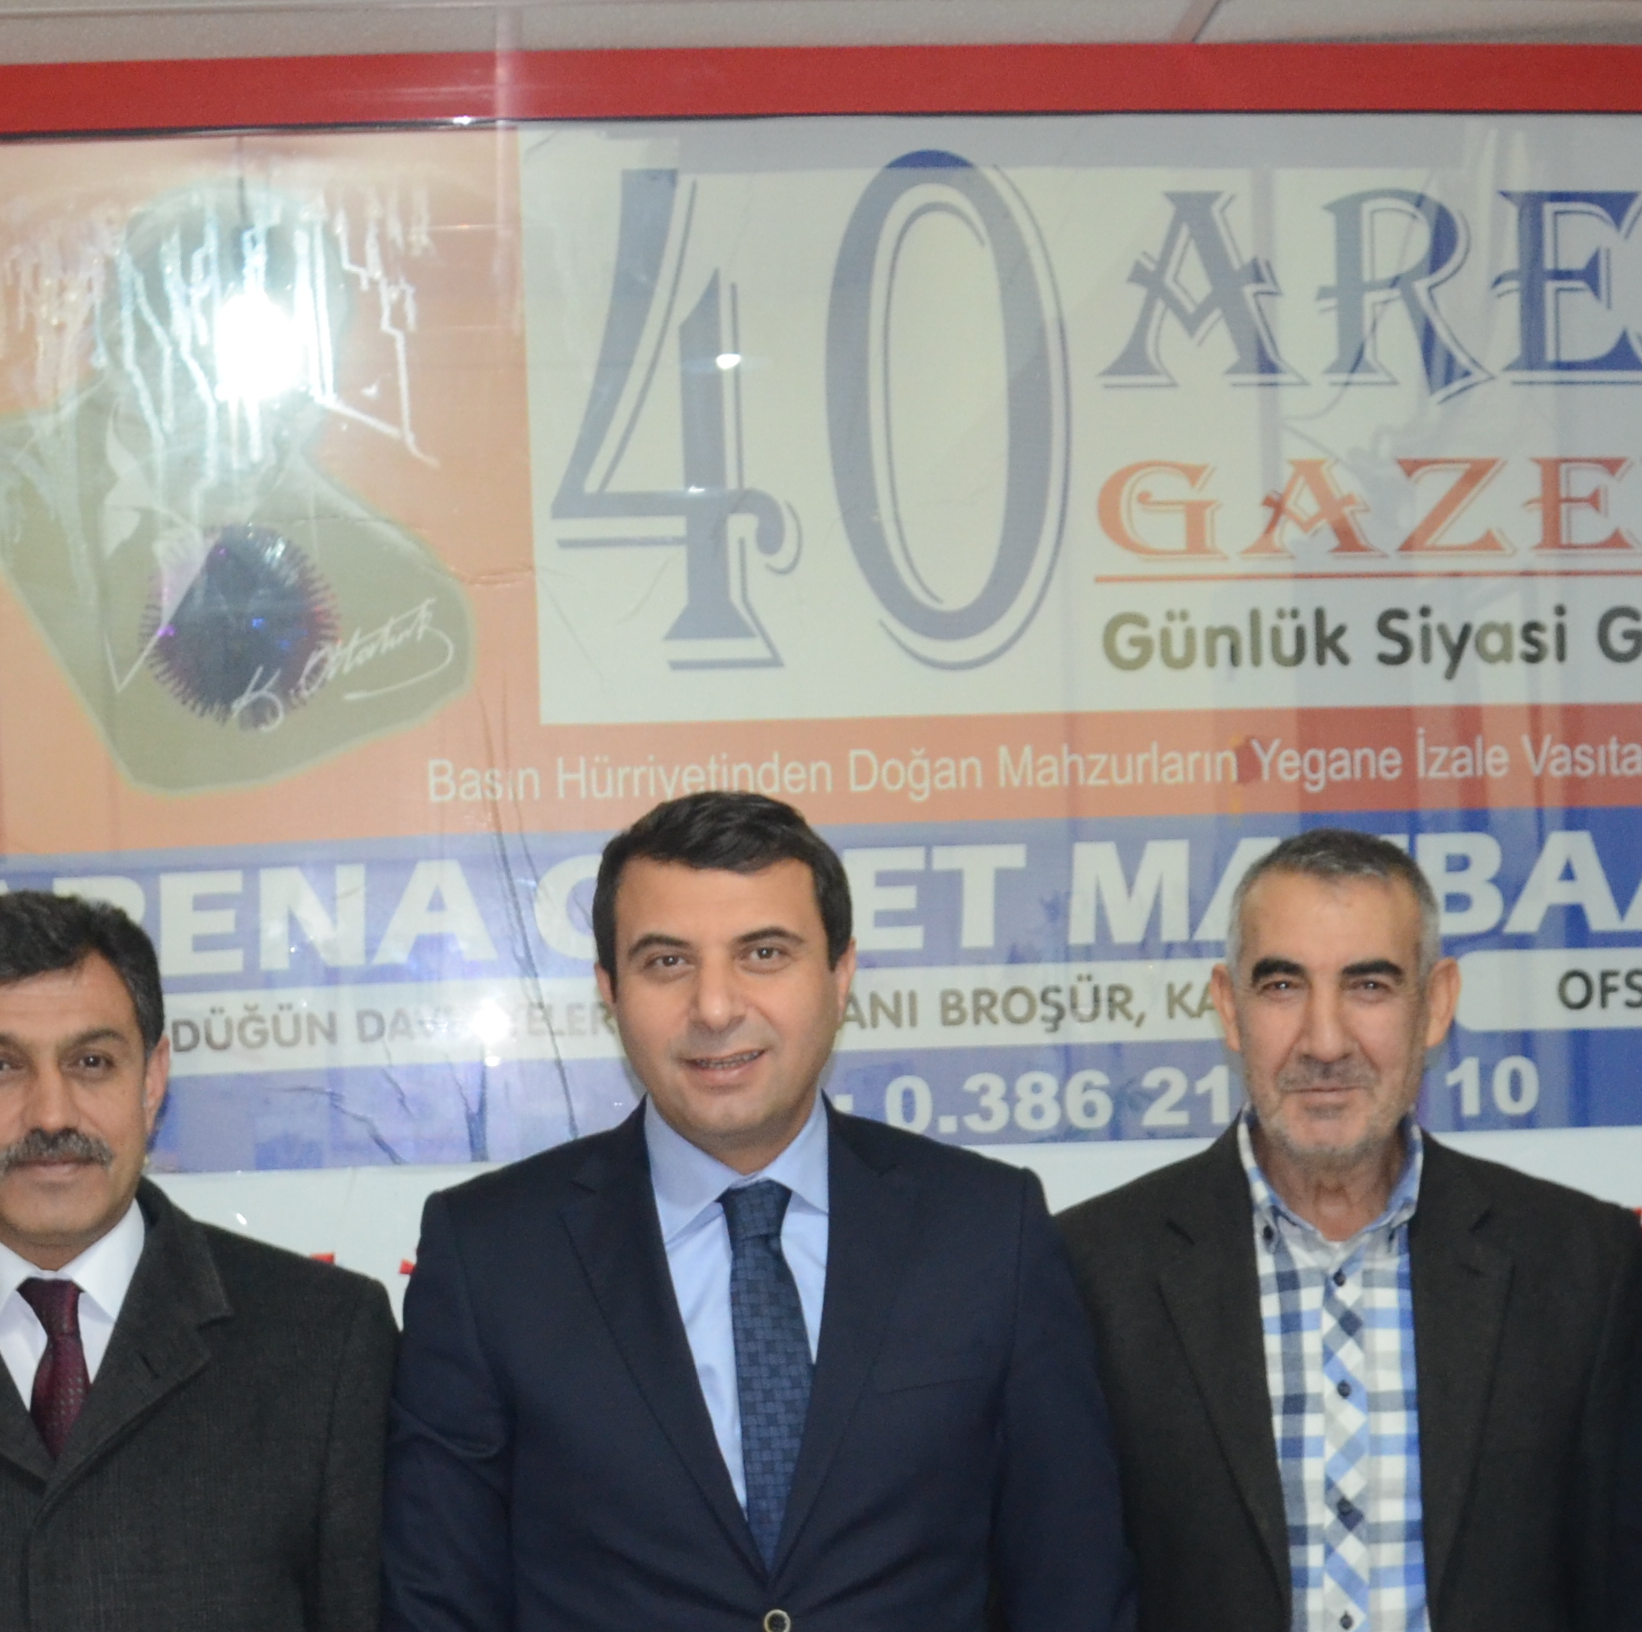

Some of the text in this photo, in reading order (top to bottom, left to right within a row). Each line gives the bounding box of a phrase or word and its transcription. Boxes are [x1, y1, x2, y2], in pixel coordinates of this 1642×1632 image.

[550, 148, 1072, 671] 40
[1102, 605, 1351, 672] Günlük
[1375, 603, 1568, 681] Siyasi
[427, 756, 541, 803] Basın
[556, 751, 835, 801] Hürriyetinden
[848, 746, 983, 801] Doğan
[996, 741, 1239, 790] Mahzurların
[1250, 737, 1403, 794] Yegane
[1415, 727, 1510, 780] İzale
[171, 1003, 339, 1053] DÜĞÜN
[939, 973, 1147, 1033] BROŞÜR,
[884, 1066, 1113, 1136] 0.386
[1445, 1053, 1540, 1117] 10
